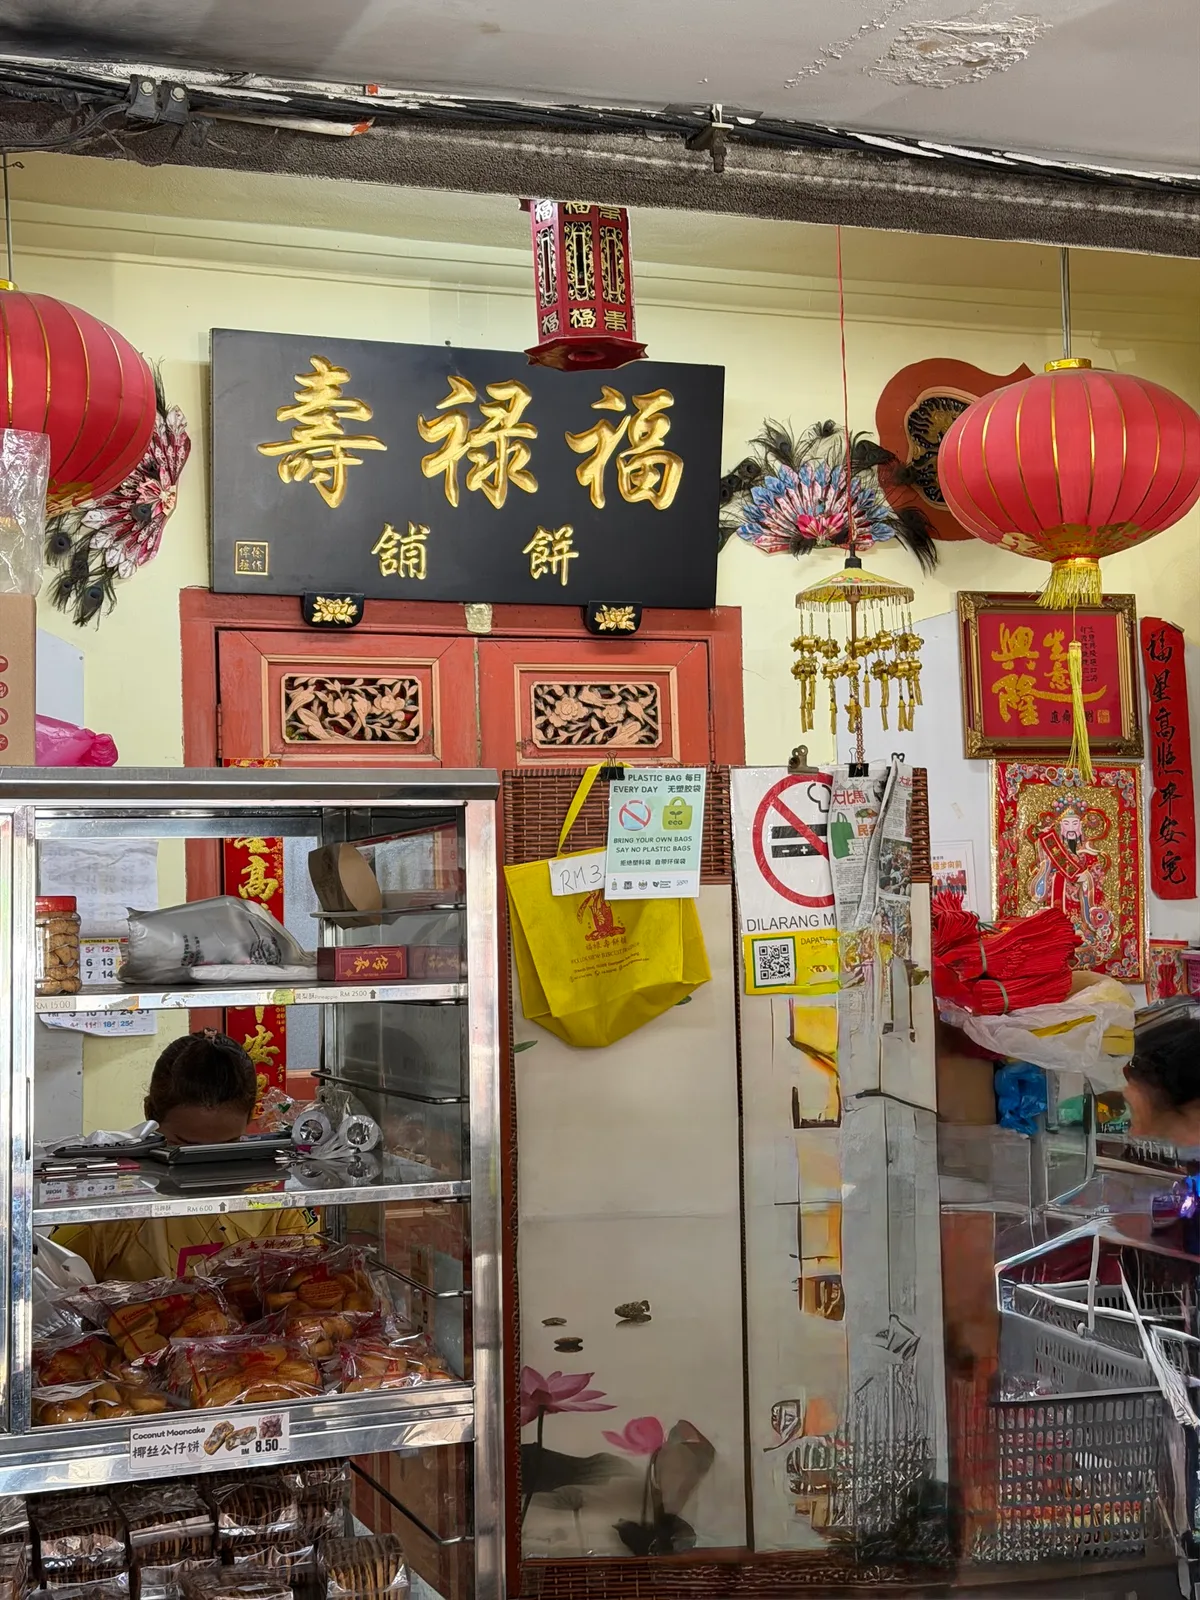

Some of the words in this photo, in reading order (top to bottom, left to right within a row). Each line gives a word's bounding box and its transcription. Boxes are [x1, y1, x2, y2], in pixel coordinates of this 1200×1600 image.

[570, 308, 596, 329] 福
[628, 774, 662, 782] PLASTIC
[665, 774, 682, 782] BAG
[685, 773, 701, 782] 每日
[667, 785, 701, 793] 无塑胶袋
[746, 914, 820, 932] DILARANG
[86, 959, 93, 967] 6
[101, 958, 113, 966] 13
[86, 971, 93, 979] 7
[102, 971, 113, 979] 14
[132, 1430, 166, 1441] Coconut
[166, 1427, 206, 1438] Mooncake
[132, 1440, 200, 1459] 椰丝公仔饼
[255, 1438, 279, 1453] 8.50
